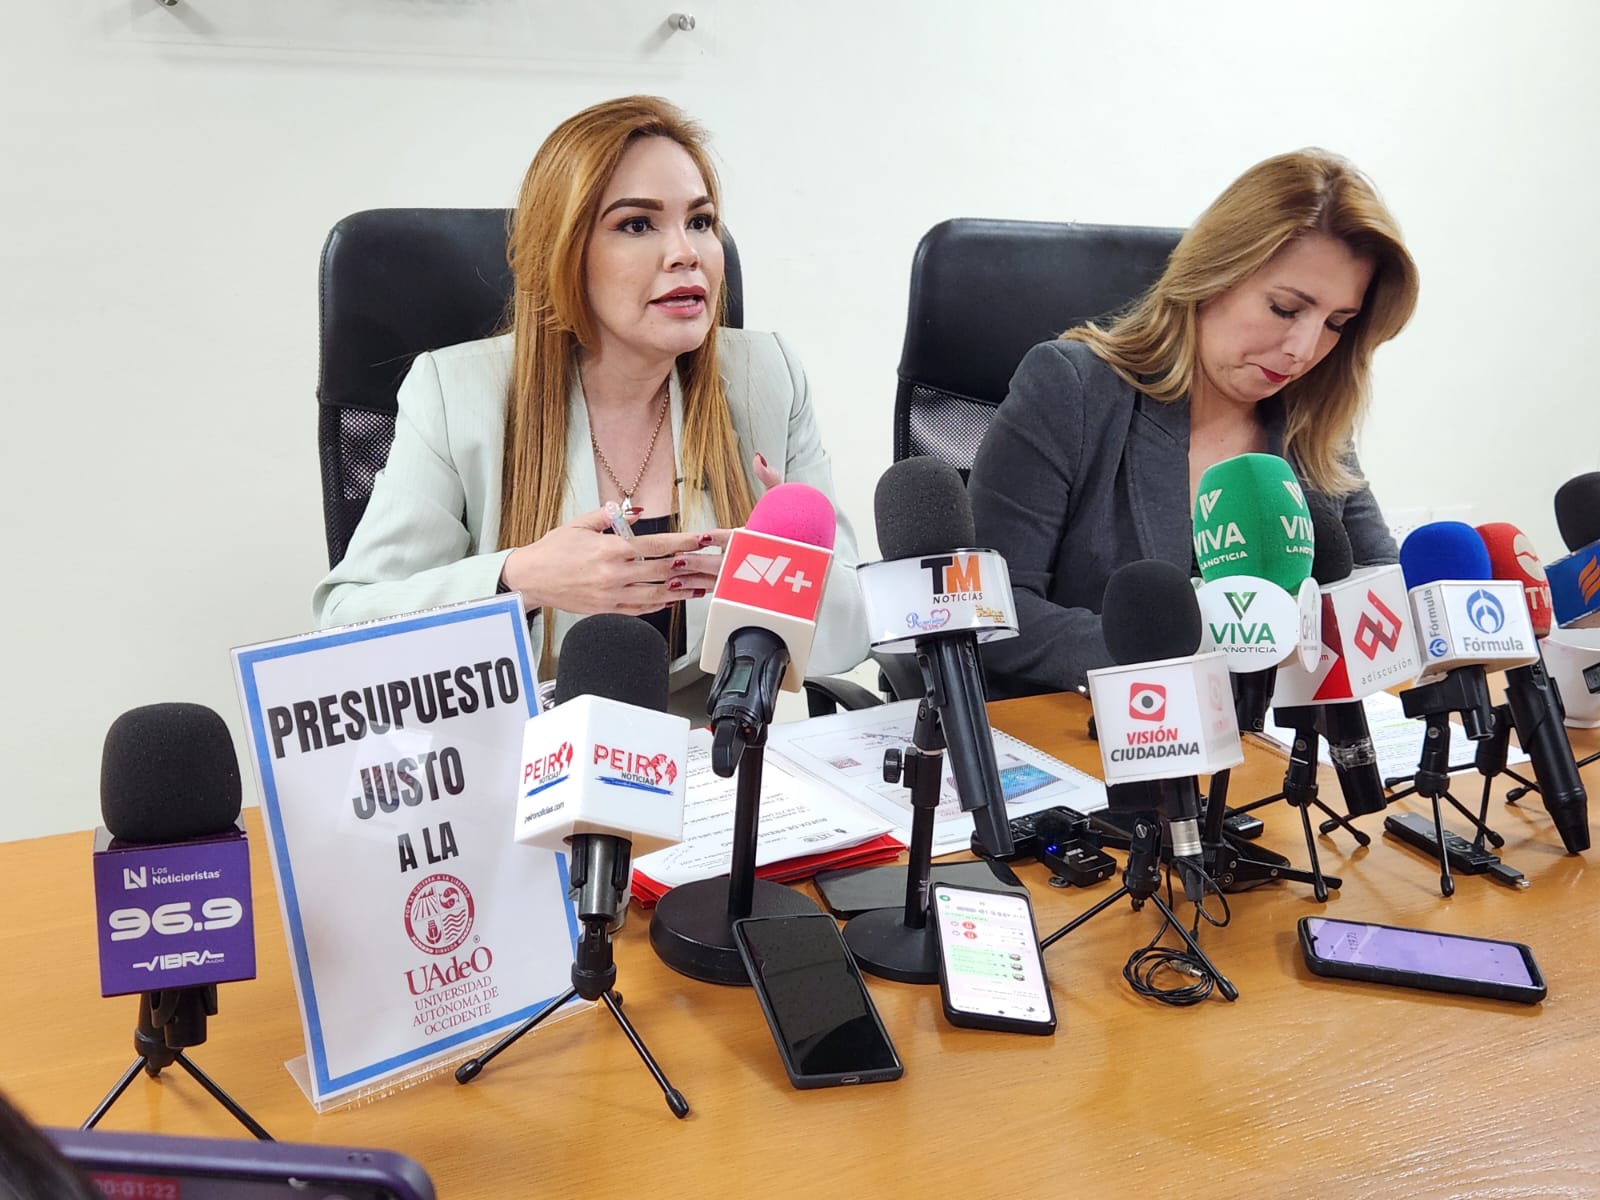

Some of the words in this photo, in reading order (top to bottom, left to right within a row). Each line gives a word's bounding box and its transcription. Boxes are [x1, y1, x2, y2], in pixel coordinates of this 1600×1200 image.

[1193, 522, 1246, 557] VIVA
[921, 554, 982, 595] TM
[933, 592, 983, 604] NOTICIAS
[1424, 588, 1440, 638] Fórmula
[1208, 622, 1276, 645] VIVA
[1463, 636, 1524, 653] Fórmula
[1361, 657, 1413, 686] adiscusión
[267, 656, 519, 759] PRESUPUESTO
[1111, 742, 1200, 762] CIUDADANA
[1126, 725, 1178, 745] VISIÓN
[351, 746, 465, 821] JUSTO
[621, 772, 655, 786] NOTICIAS
[398, 833, 418, 873] A
[422, 821, 459, 864] LA
[152, 870, 221, 885] Noticieristas
[108, 897, 243, 942] 96.9
[132, 950, 225, 972] VIBRA
[404, 946, 493, 996] UAdeO
[413, 994, 481, 1027] AUTÓNOMA
[482, 986, 500, 1001] DE
[414, 975, 492, 1011] UNIVERSIDAD
[424, 1002, 492, 1036] OCCIDENTE
[97, 1180, 177, 1199] 0:01:22
